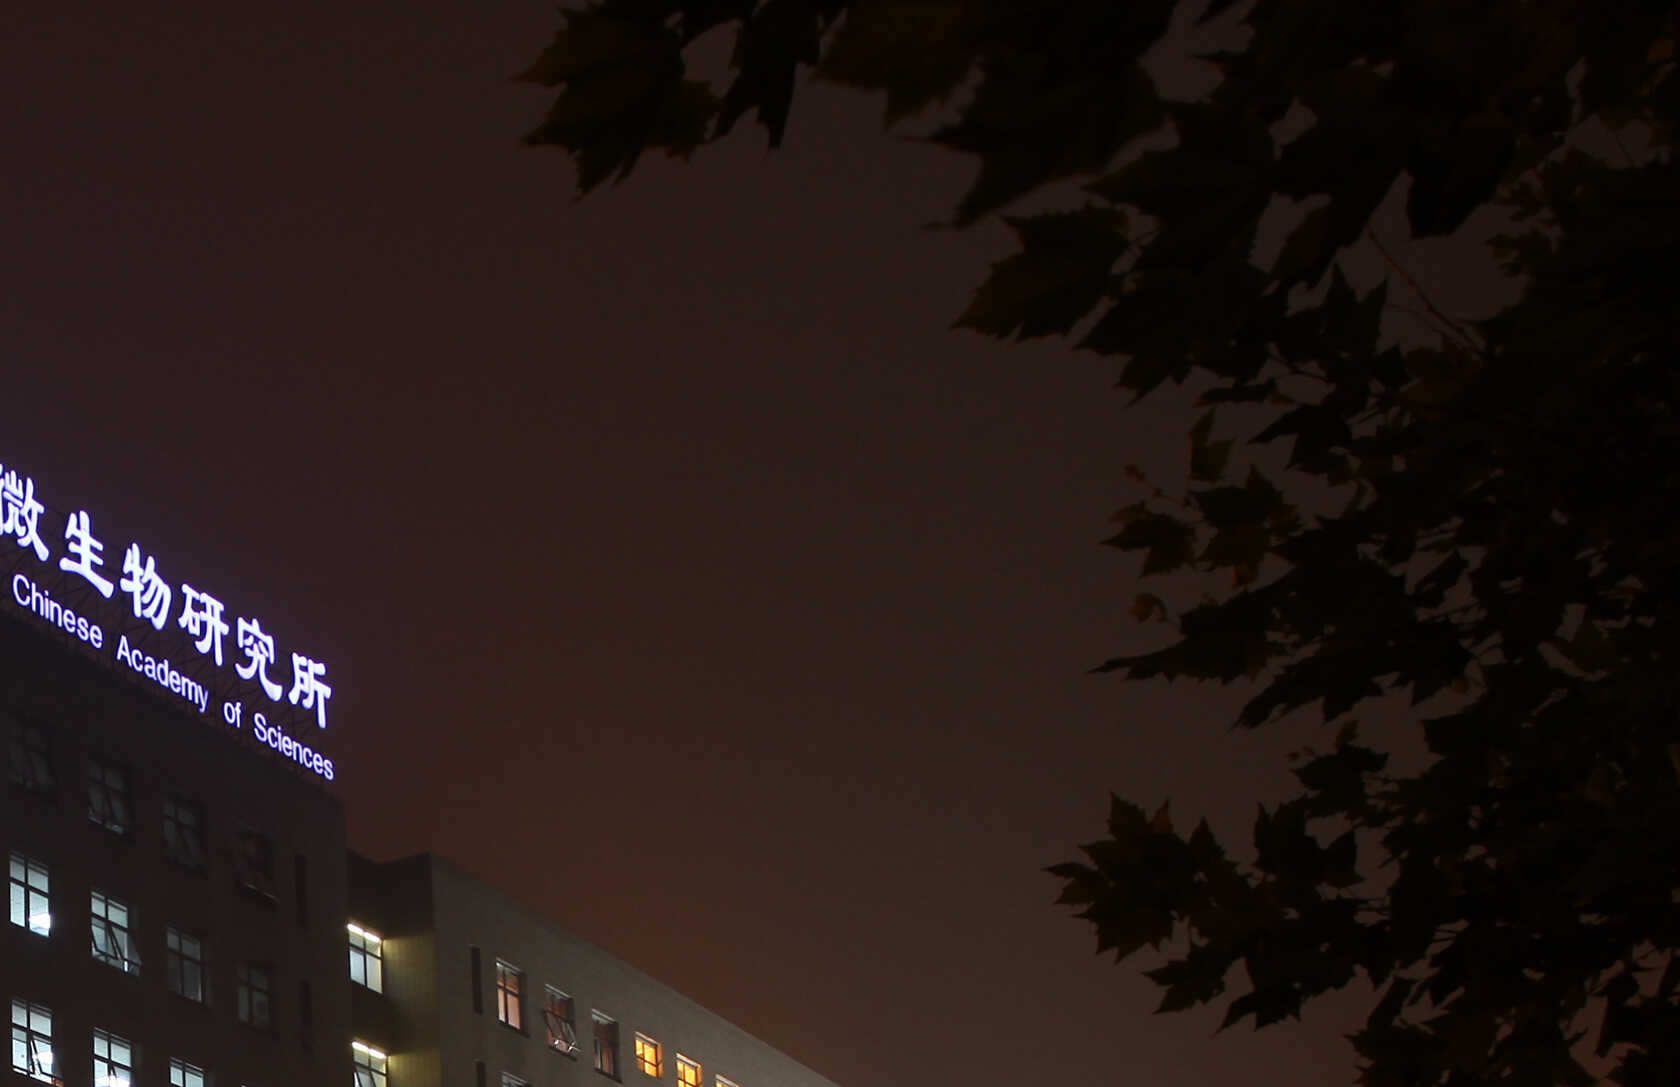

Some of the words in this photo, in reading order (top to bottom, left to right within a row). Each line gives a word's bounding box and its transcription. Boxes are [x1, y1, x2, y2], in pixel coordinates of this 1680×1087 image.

[12, 574, 103, 649] Chinese
[116, 634, 209, 713] Academy
[223, 701, 242, 728] of
[253, 712, 334, 781] Sciences
